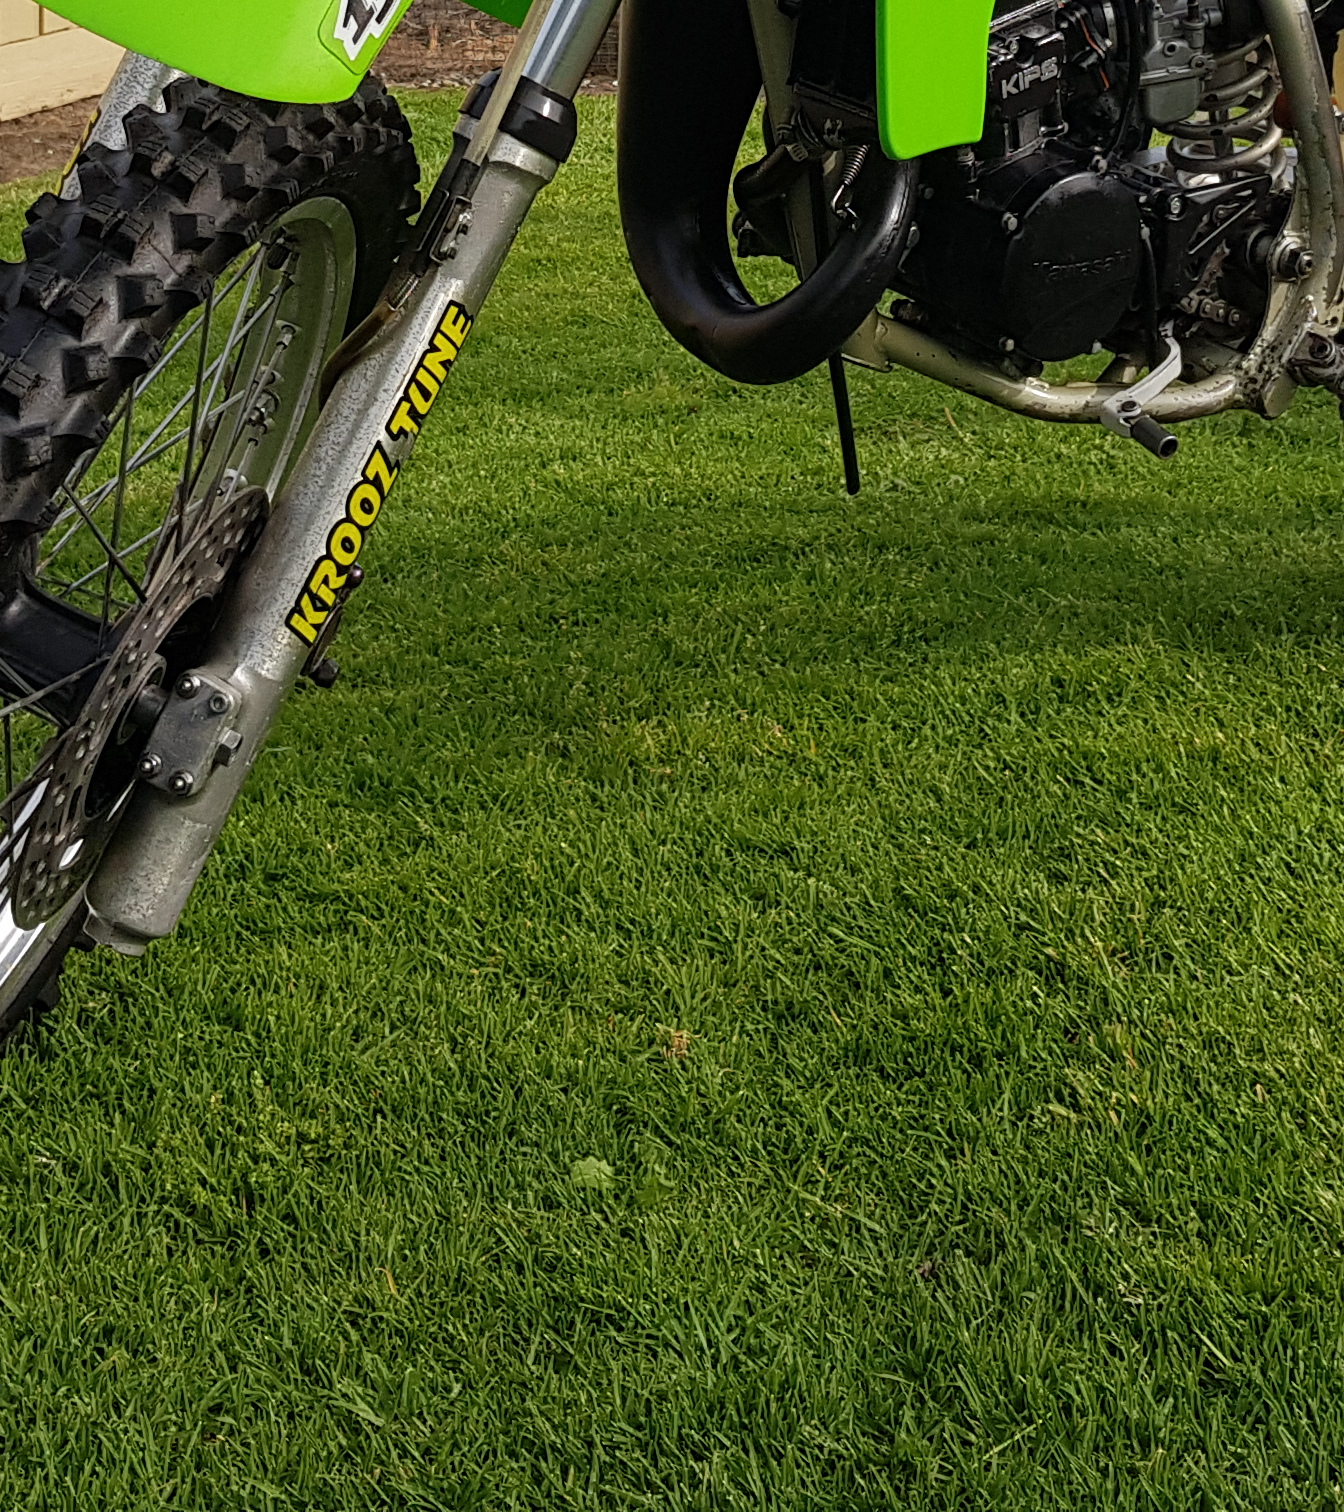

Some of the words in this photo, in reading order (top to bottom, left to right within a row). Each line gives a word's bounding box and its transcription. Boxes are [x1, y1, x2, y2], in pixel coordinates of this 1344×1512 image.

[1001, 56, 1058, 99] KIPS
[286, 442, 400, 647] KROOZ
[387, 301, 474, 440] TUNE
